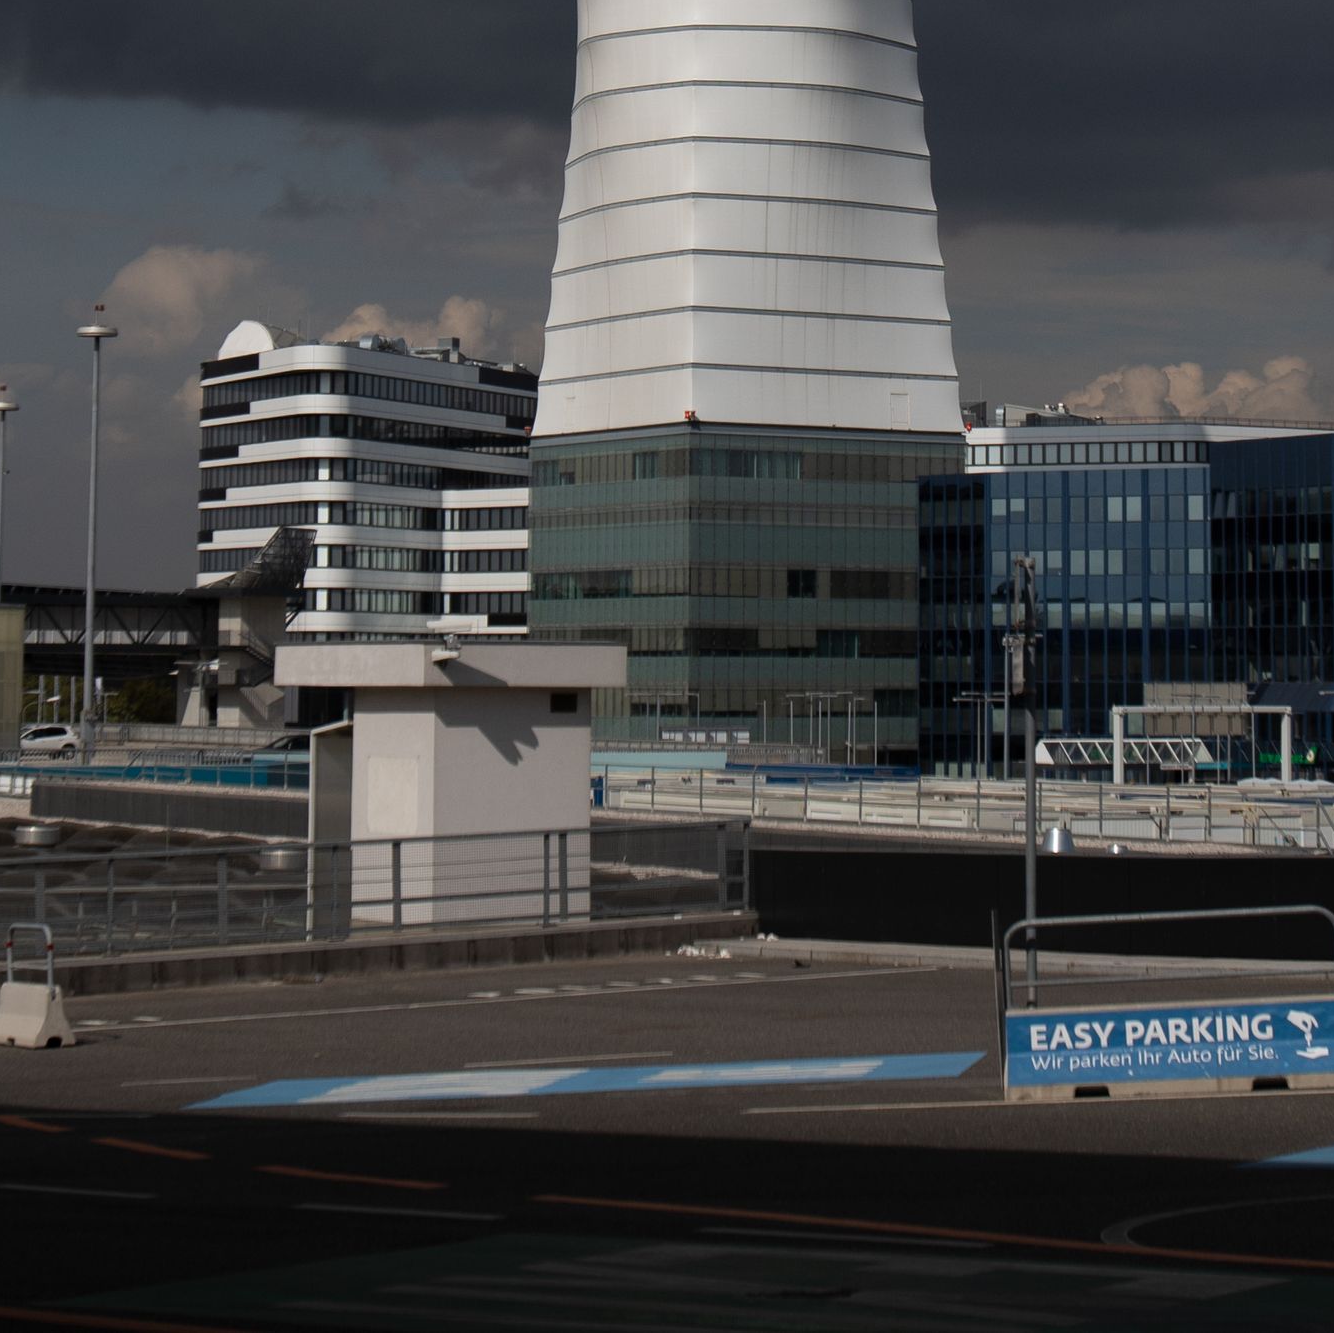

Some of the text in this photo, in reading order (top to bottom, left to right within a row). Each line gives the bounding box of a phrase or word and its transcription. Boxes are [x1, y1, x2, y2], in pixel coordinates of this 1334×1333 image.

[1029, 1013, 1274, 1051] EASY PARKING
[1031, 1043, 1280, 1072] Wir parken Ihr Auto für Sie.
